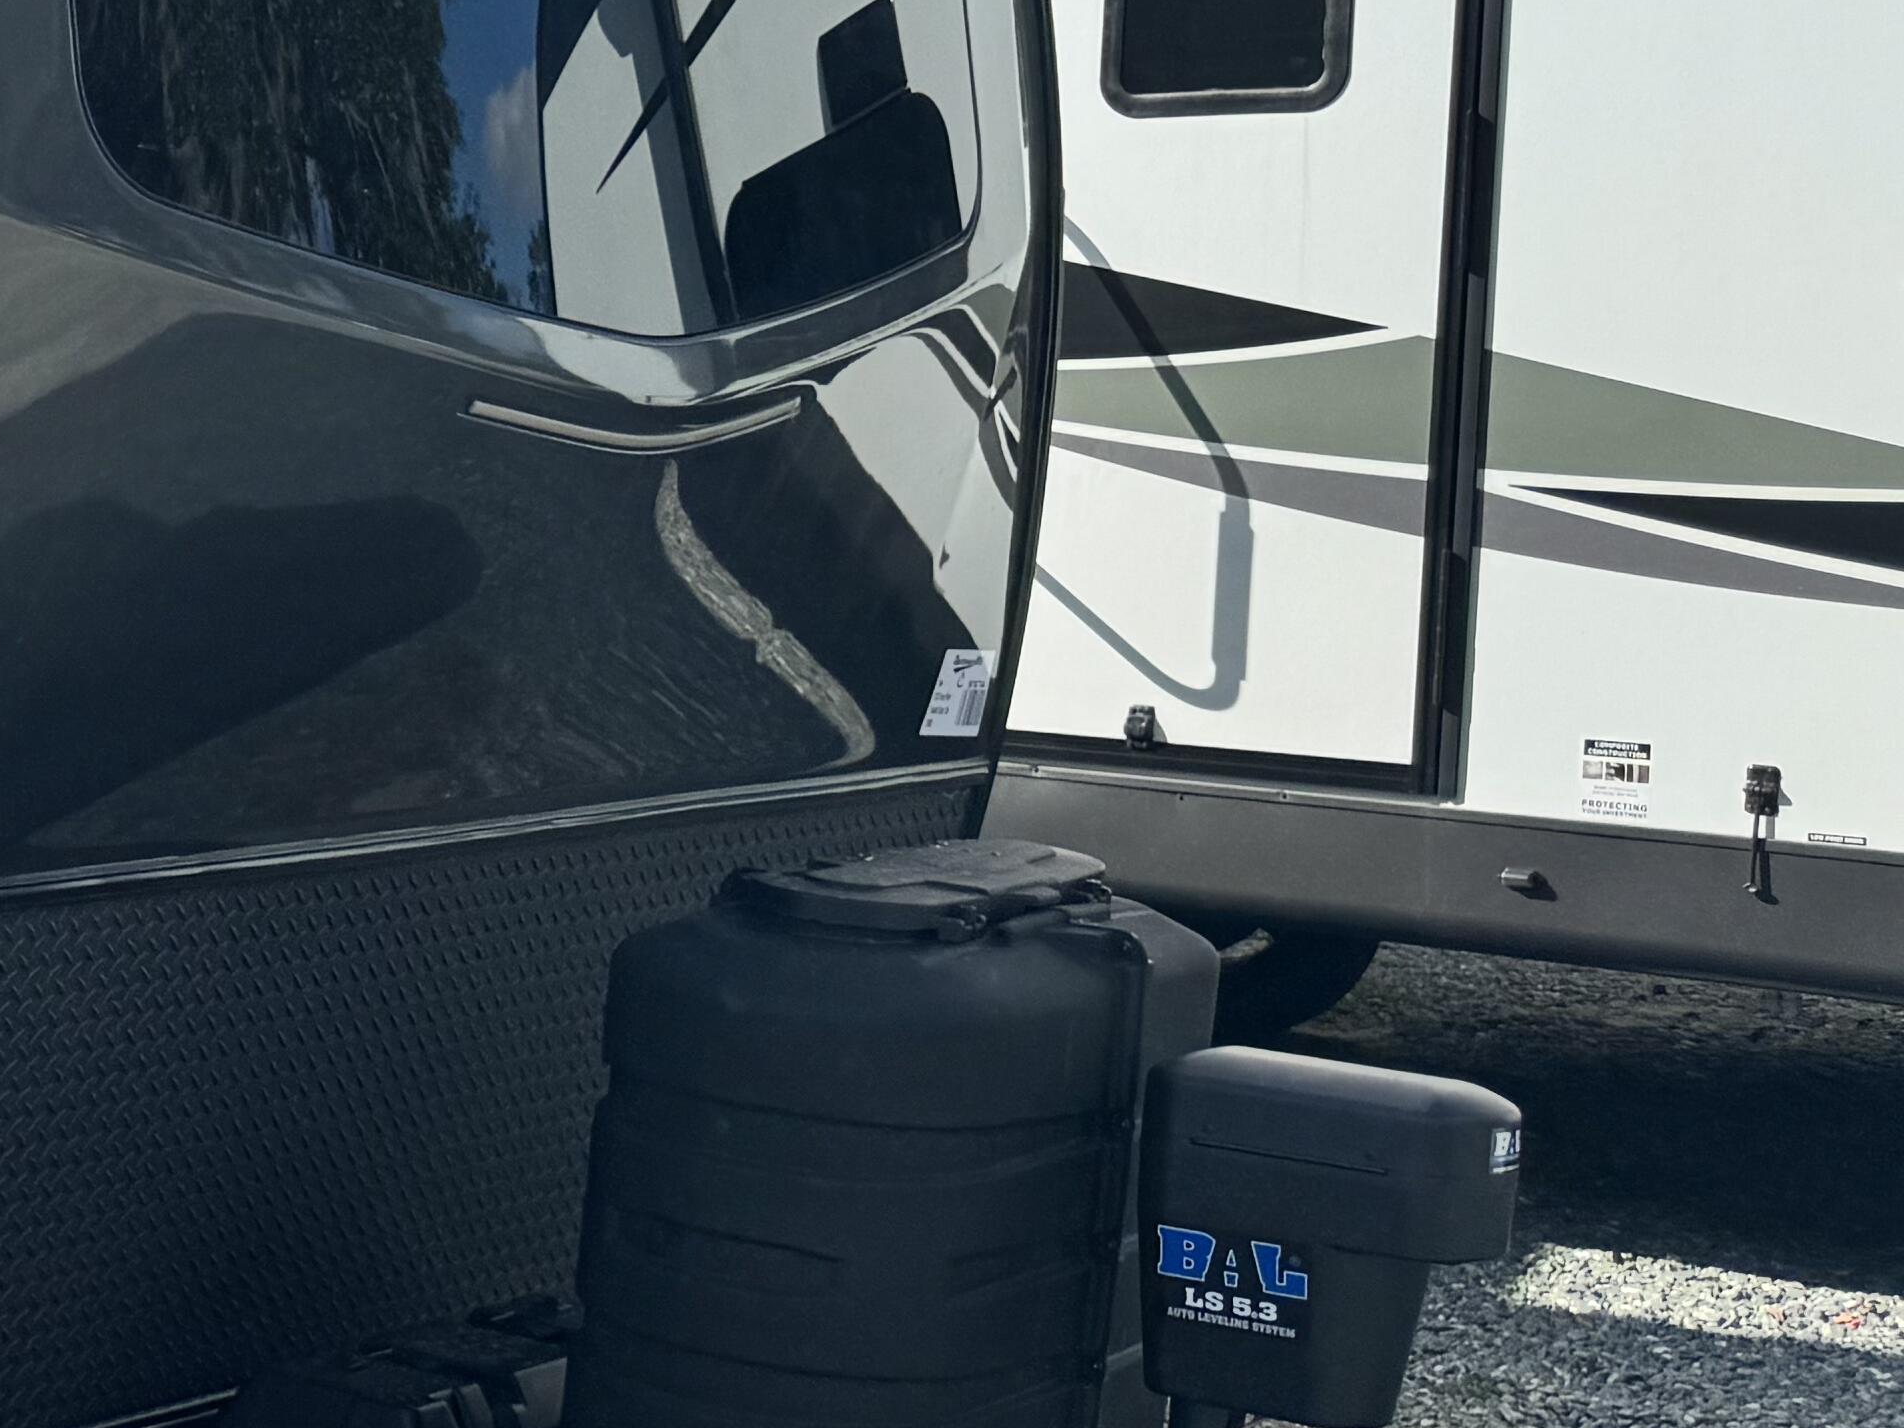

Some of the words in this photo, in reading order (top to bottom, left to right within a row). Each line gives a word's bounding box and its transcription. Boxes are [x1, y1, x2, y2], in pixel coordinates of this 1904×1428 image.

[1581, 798, 1648, 812] PROTECTING
[1185, 1287, 1224, 1311] LS
[1232, 1296, 1277, 1321] 5.3
[1167, 1306, 1195, 1320] AUTO
[1198, 1312, 1249, 1329] LEVELING
[1252, 1322, 1295, 1338] SYSTEM
